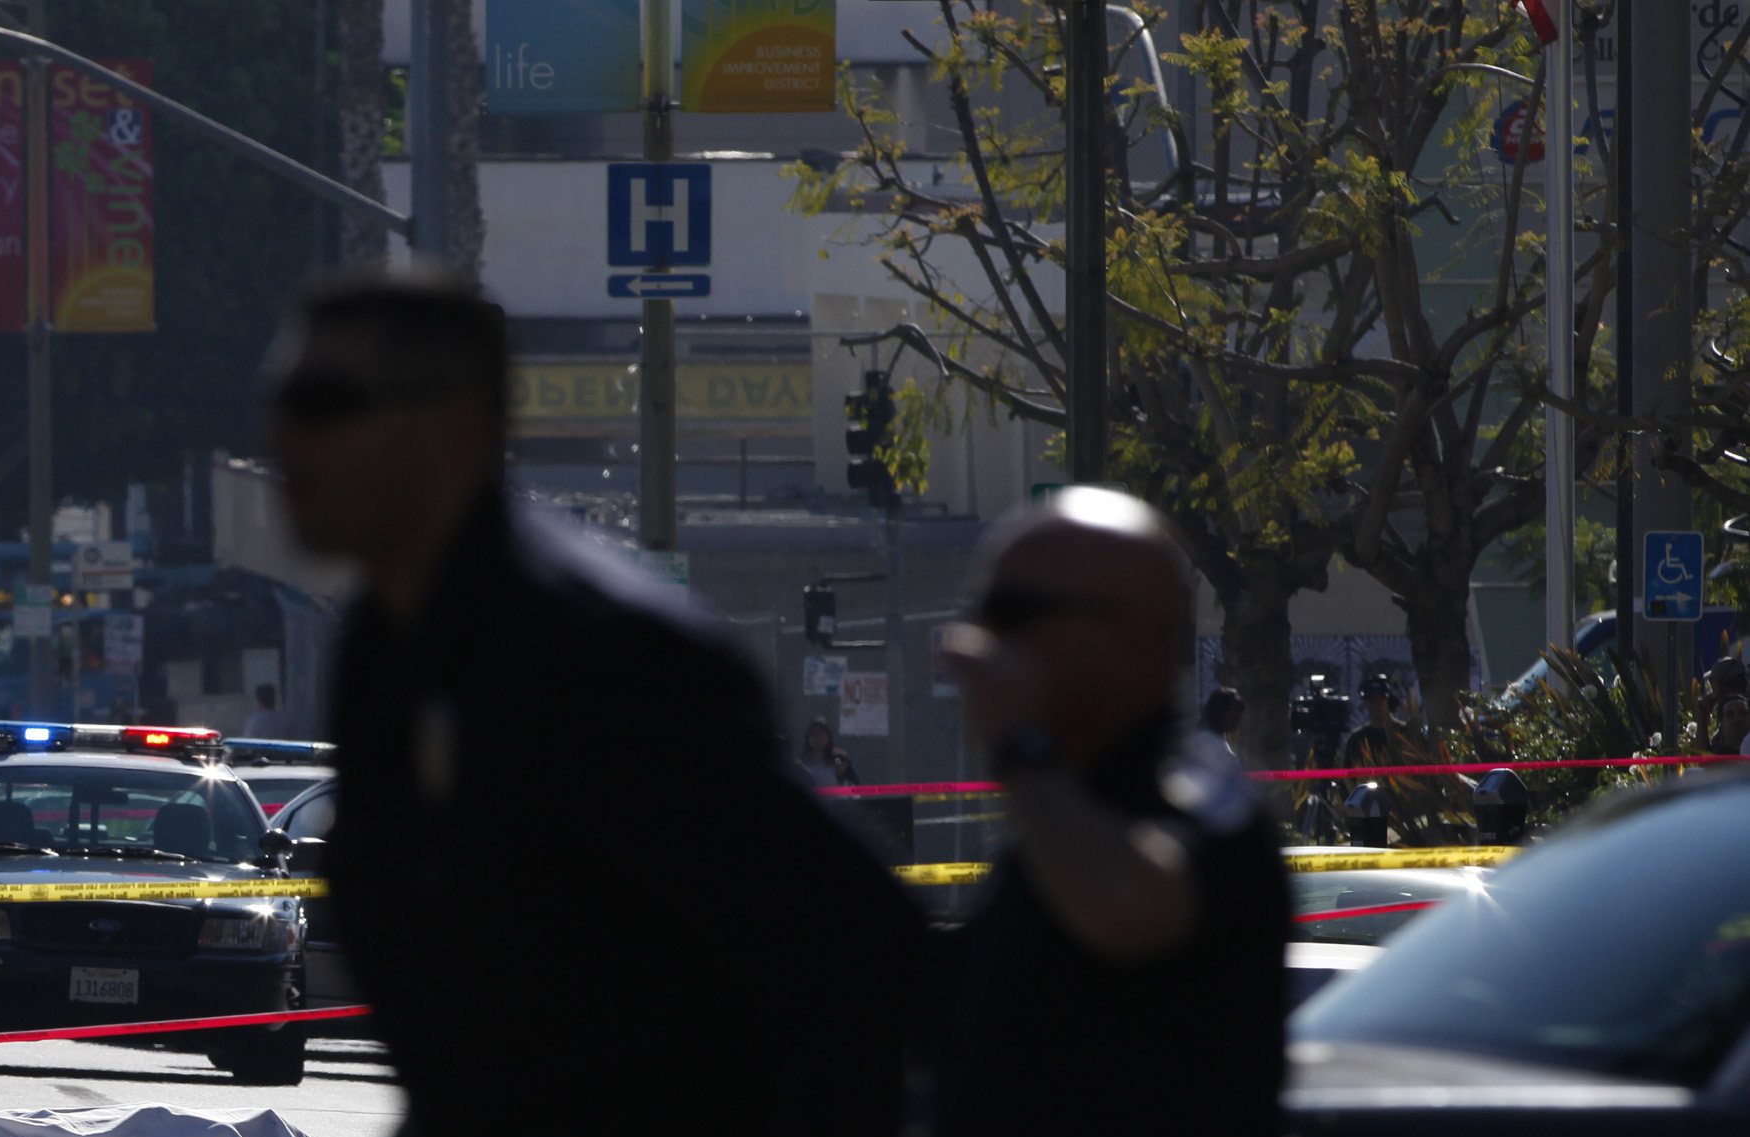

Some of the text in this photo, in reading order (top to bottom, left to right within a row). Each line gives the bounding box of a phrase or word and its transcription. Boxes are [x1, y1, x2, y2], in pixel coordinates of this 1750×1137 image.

[756, 46, 821, 59] BUSINESS
[494, 42, 554, 90] life
[722, 61, 821, 75] IMPROVEMENT
[764, 77, 821, 91] DISTRICT
